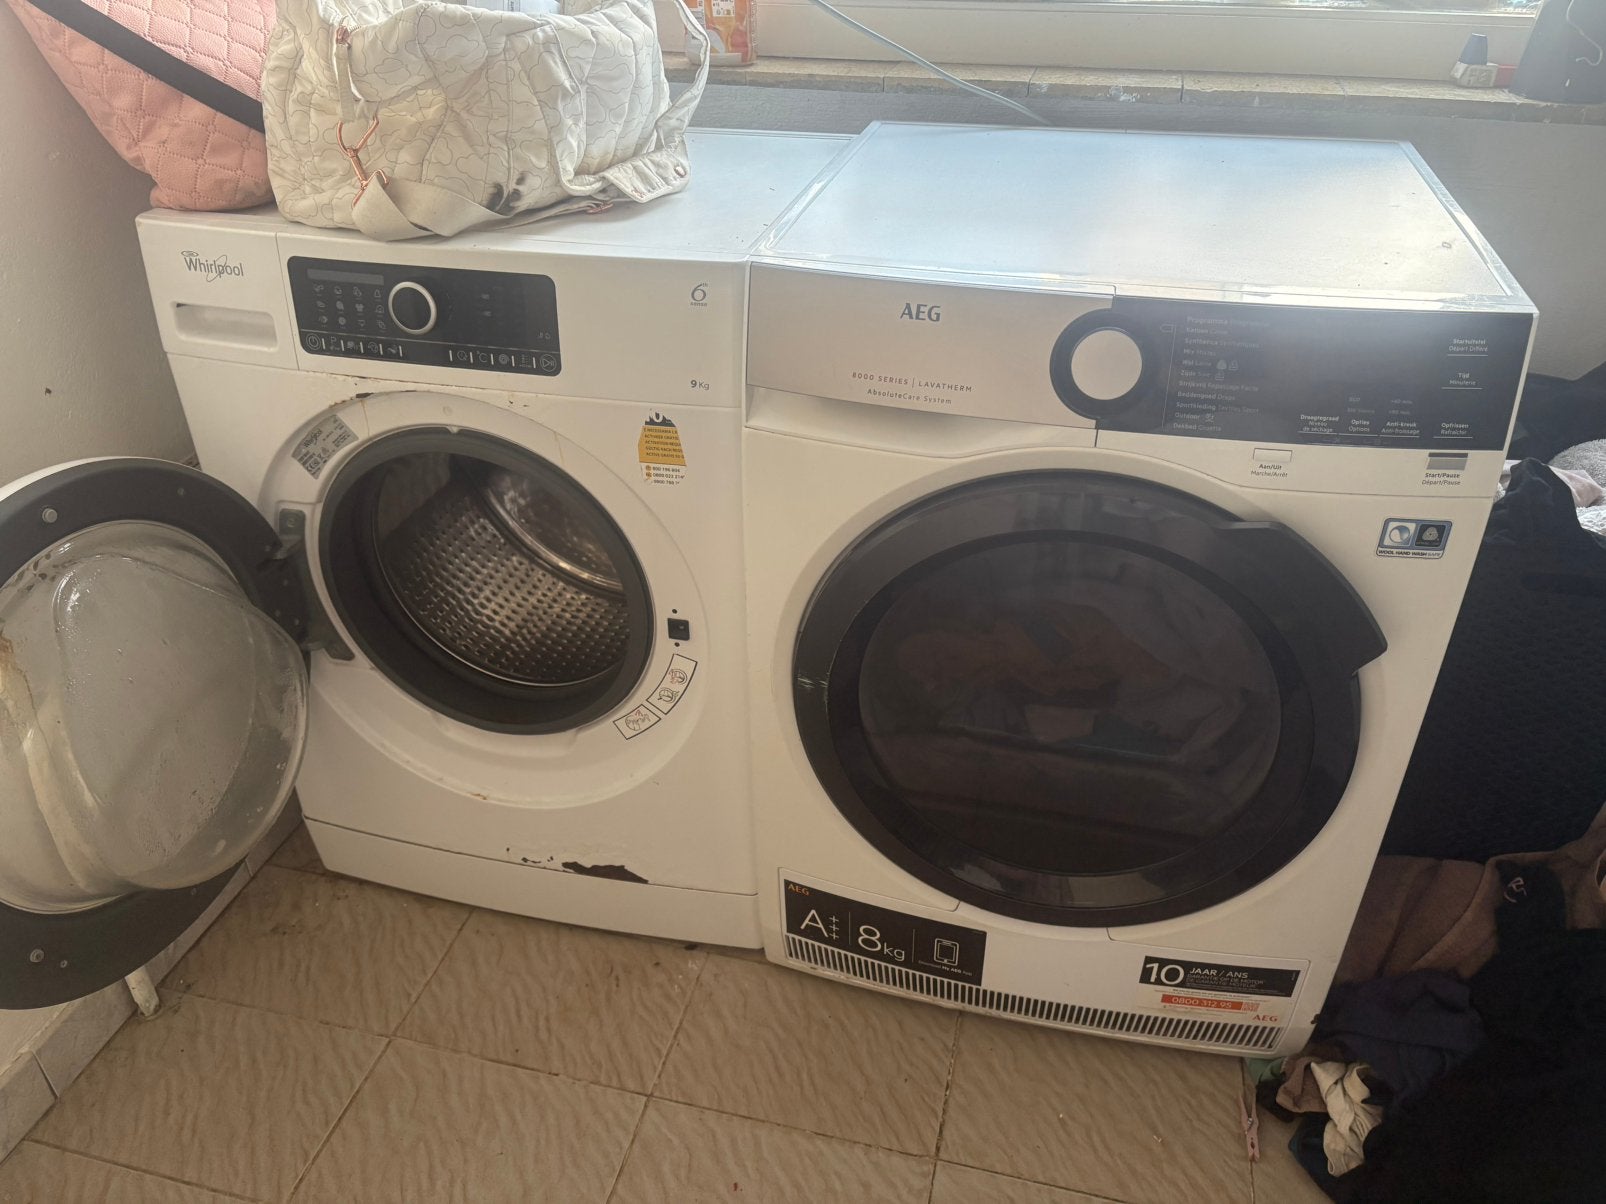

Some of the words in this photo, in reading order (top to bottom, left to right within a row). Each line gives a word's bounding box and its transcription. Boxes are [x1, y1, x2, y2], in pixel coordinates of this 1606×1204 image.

[181, 254, 244, 281] Whirlpool
[900, 302, 941, 322] AEG
[690, 379, 698, 388] 9
[699, 381, 710, 391] Kg
[852, 371, 875, 381] 8000
[878, 375, 909, 386] SERIES
[918, 380, 973, 393] LAVATHERM
[867, 388, 921, 402] AbsoluteCare
[923, 395, 952, 406] System
[1259, 463, 1282, 471] Aan/Uit
[787, 883, 810, 896] AEG
[1145, 962, 1185, 985] 10
[1189, 967, 1217, 976] JAAR
[1225, 971, 1248, 979] ANS
[1171, 997, 1199, 1005] 0800
[1200, 999, 1217, 1008] 312
[1219, 1001, 1232, 1009] 95
[1252, 1014, 1278, 1023] AEG
